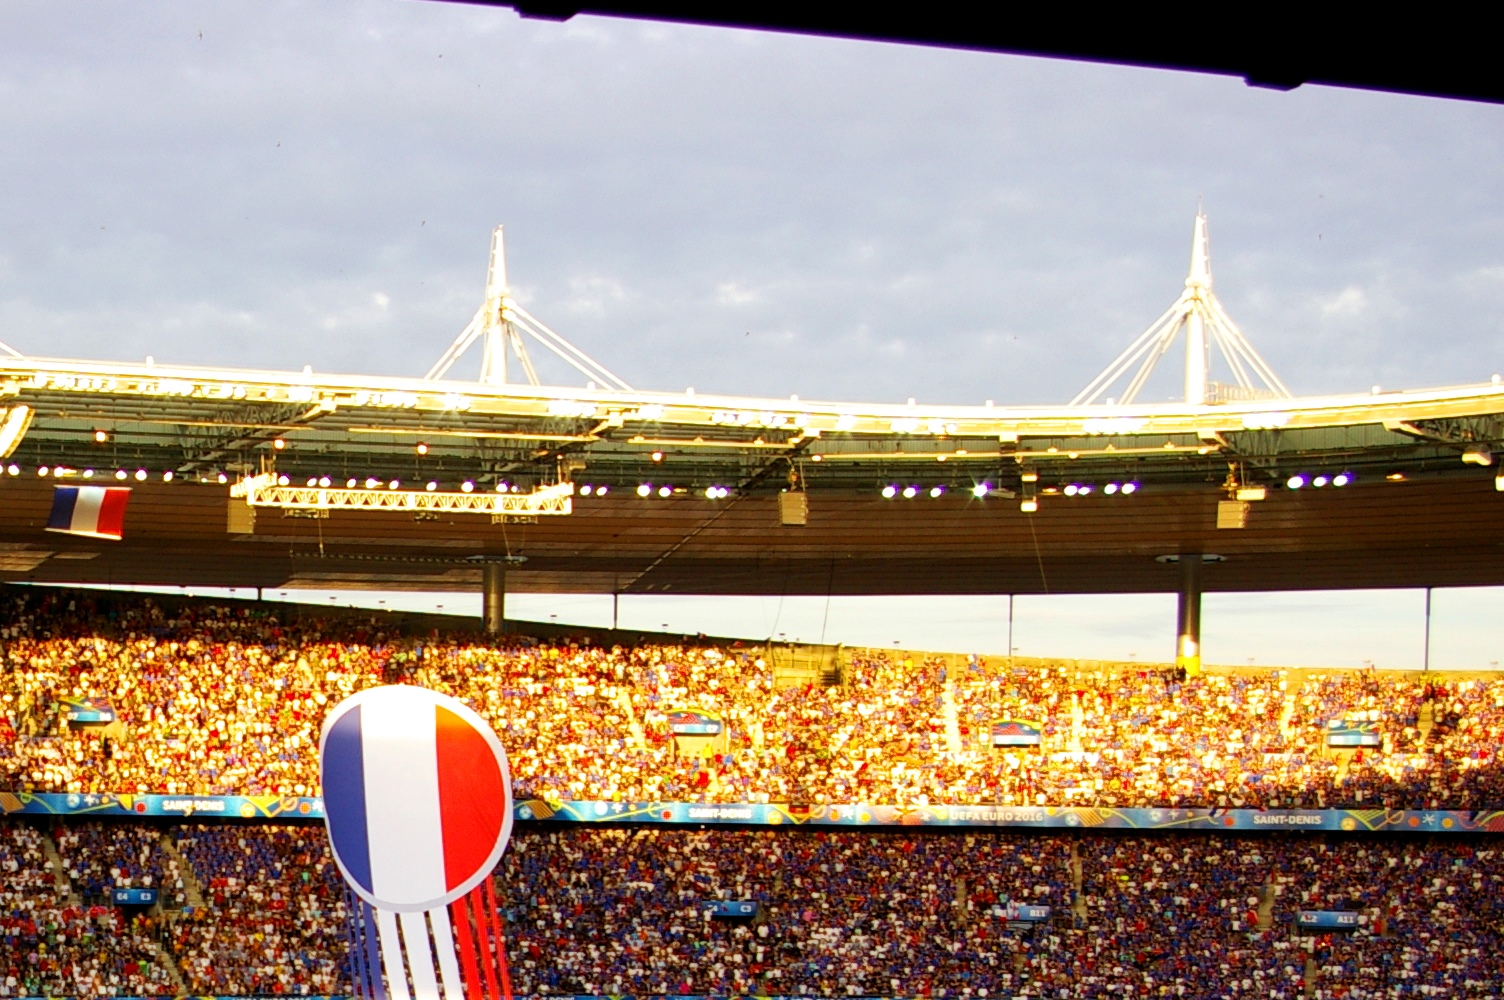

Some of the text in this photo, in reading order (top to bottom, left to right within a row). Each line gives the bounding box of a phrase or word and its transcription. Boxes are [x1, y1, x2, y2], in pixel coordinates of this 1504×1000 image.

[162, 800, 225, 811] SAINTDENIS
[950, 811, 1044, 822] UEFA EURO 2016
[1253, 814, 1322, 825] SAINT-DENIS
